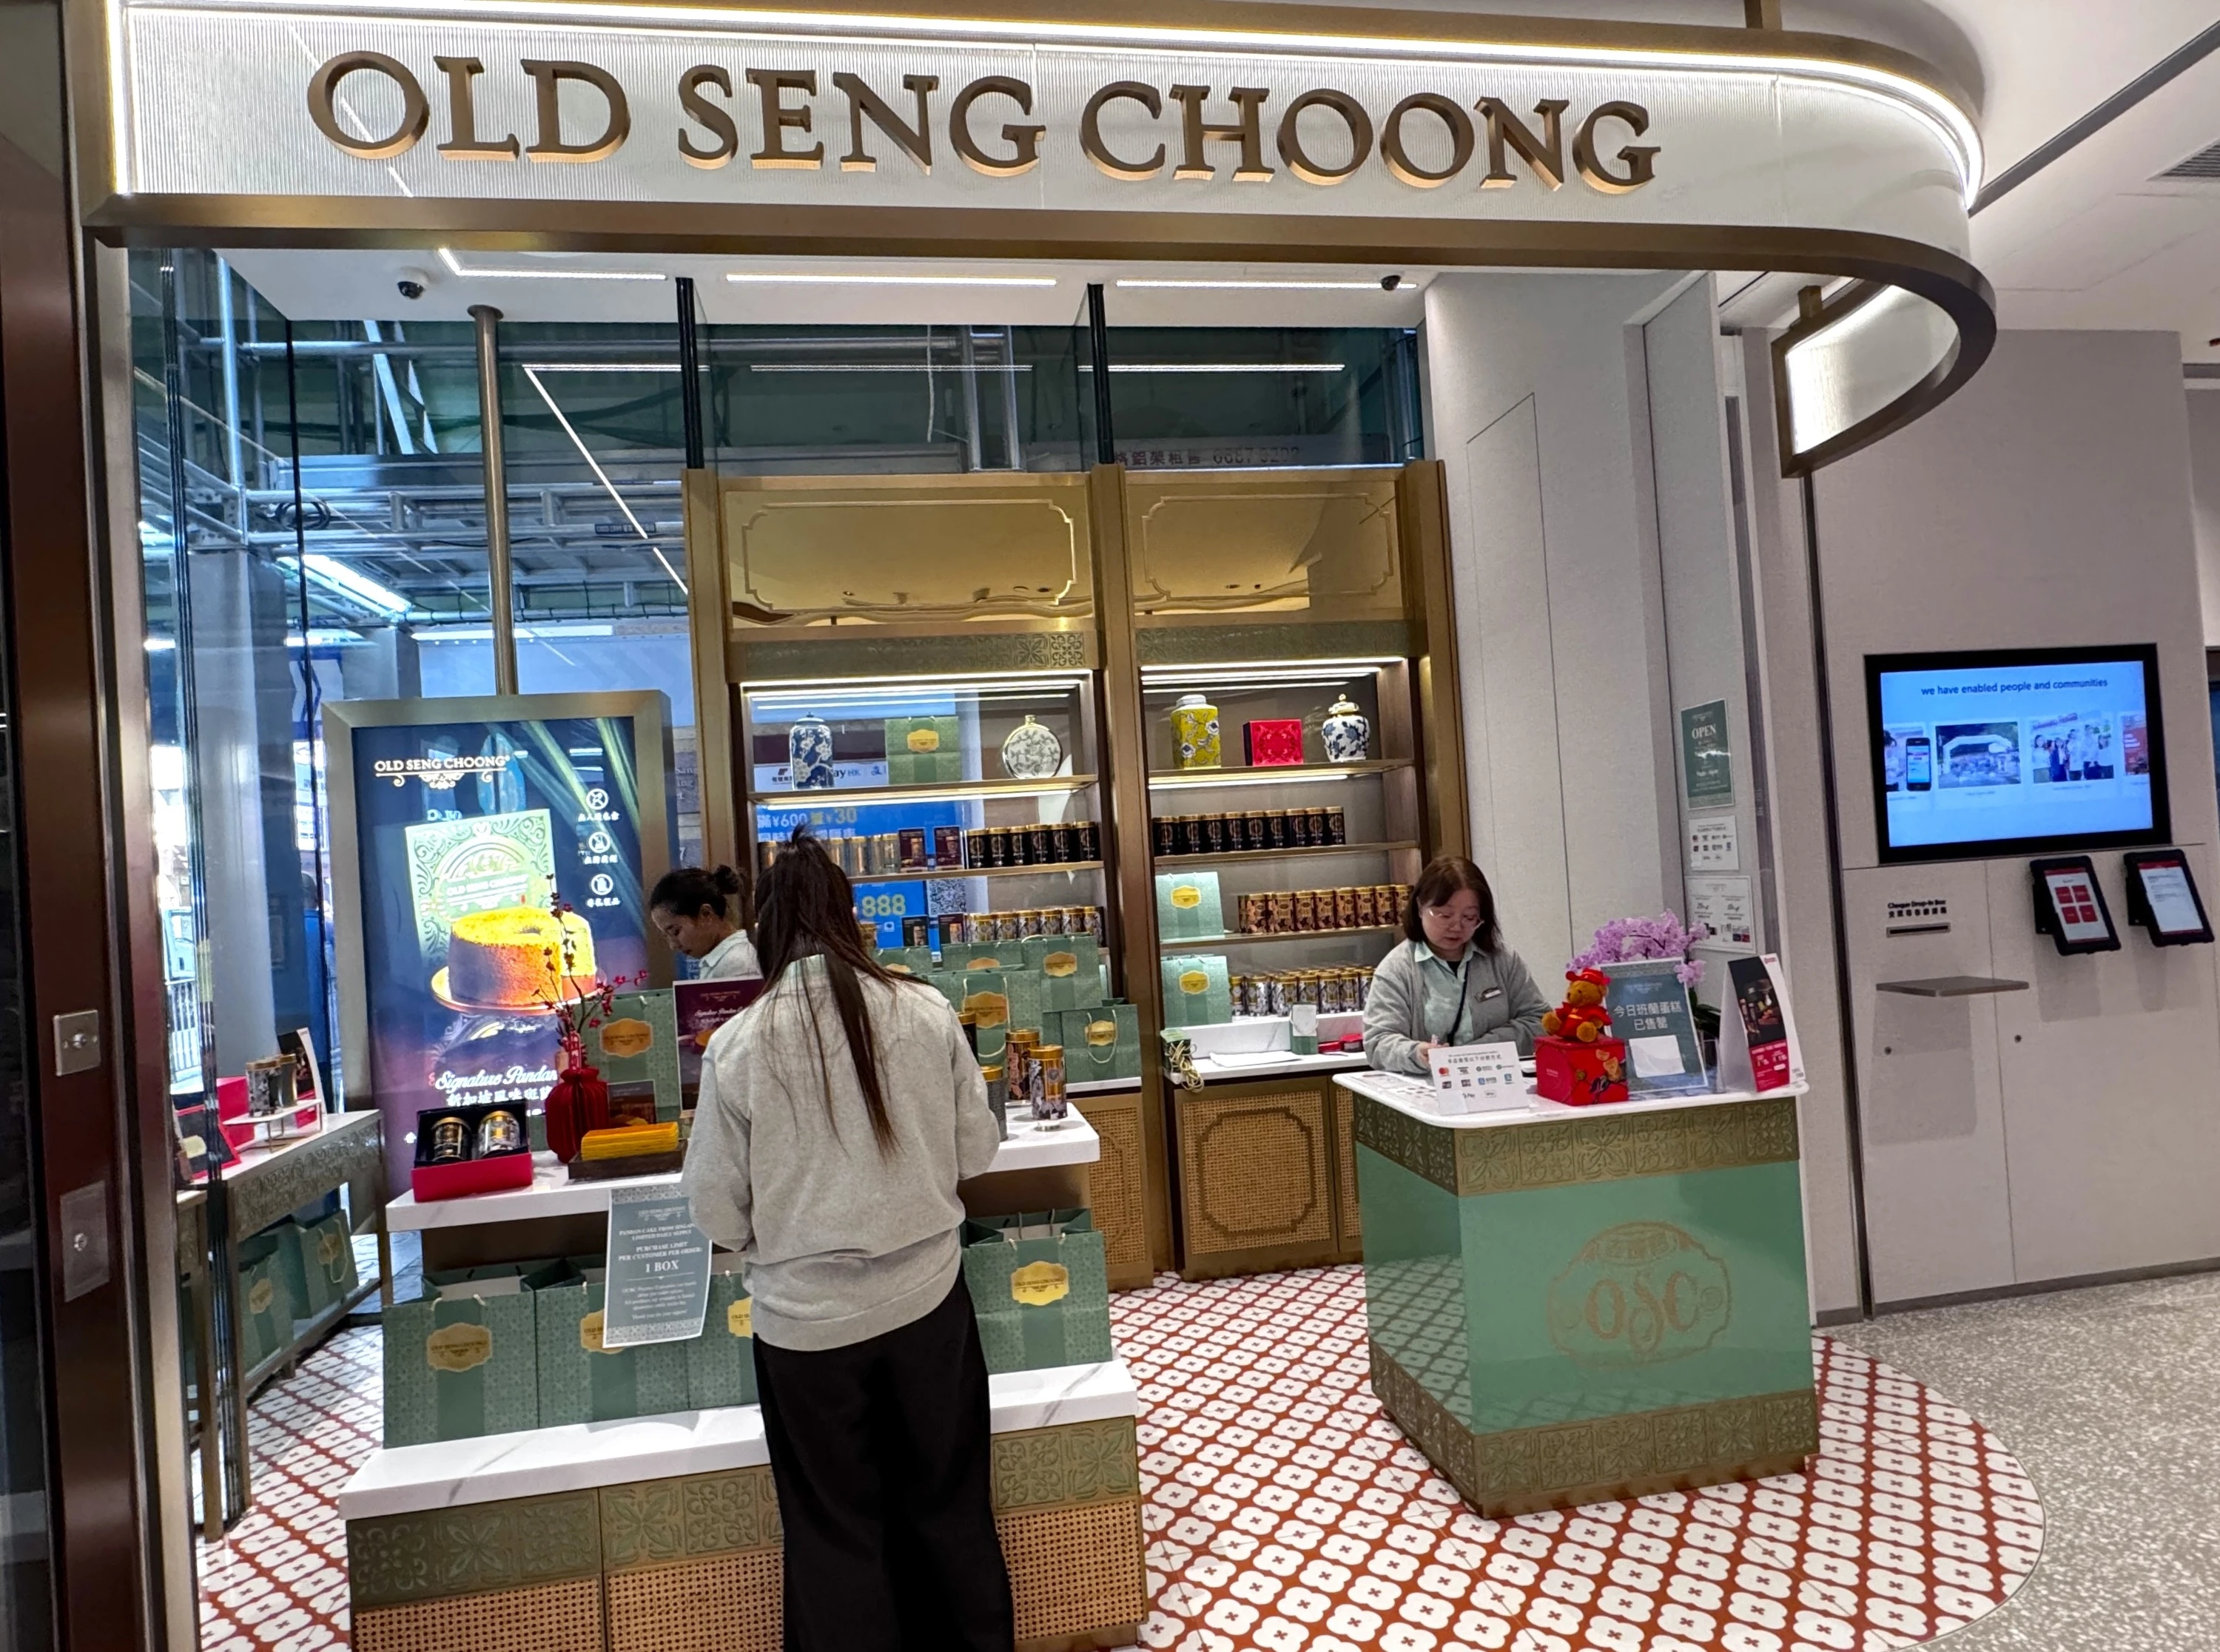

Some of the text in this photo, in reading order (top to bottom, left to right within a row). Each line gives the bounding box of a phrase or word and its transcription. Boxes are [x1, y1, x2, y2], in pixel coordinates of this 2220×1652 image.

[307, 50, 1661, 195] OLD SENG CHOONG
[1937, 686, 1959, 695] have
[1961, 683, 1998, 693] enabled
[2000, 682, 2031, 694] people
[2034, 681, 2051, 690] and
[2053, 678, 2108, 689] communities
[1692, 724, 1716, 739] OPEN
[374, 755, 506, 772] OLD SENG CHOONG
[862, 894, 906, 917] 888
[435, 1065, 558, 1093] Signature Pandan
[632, 1251, 667, 1260] CUSTOMER
[636, 1244, 669, 1253] PURCHASE
[645, 1260, 679, 1272] 1 BOX
